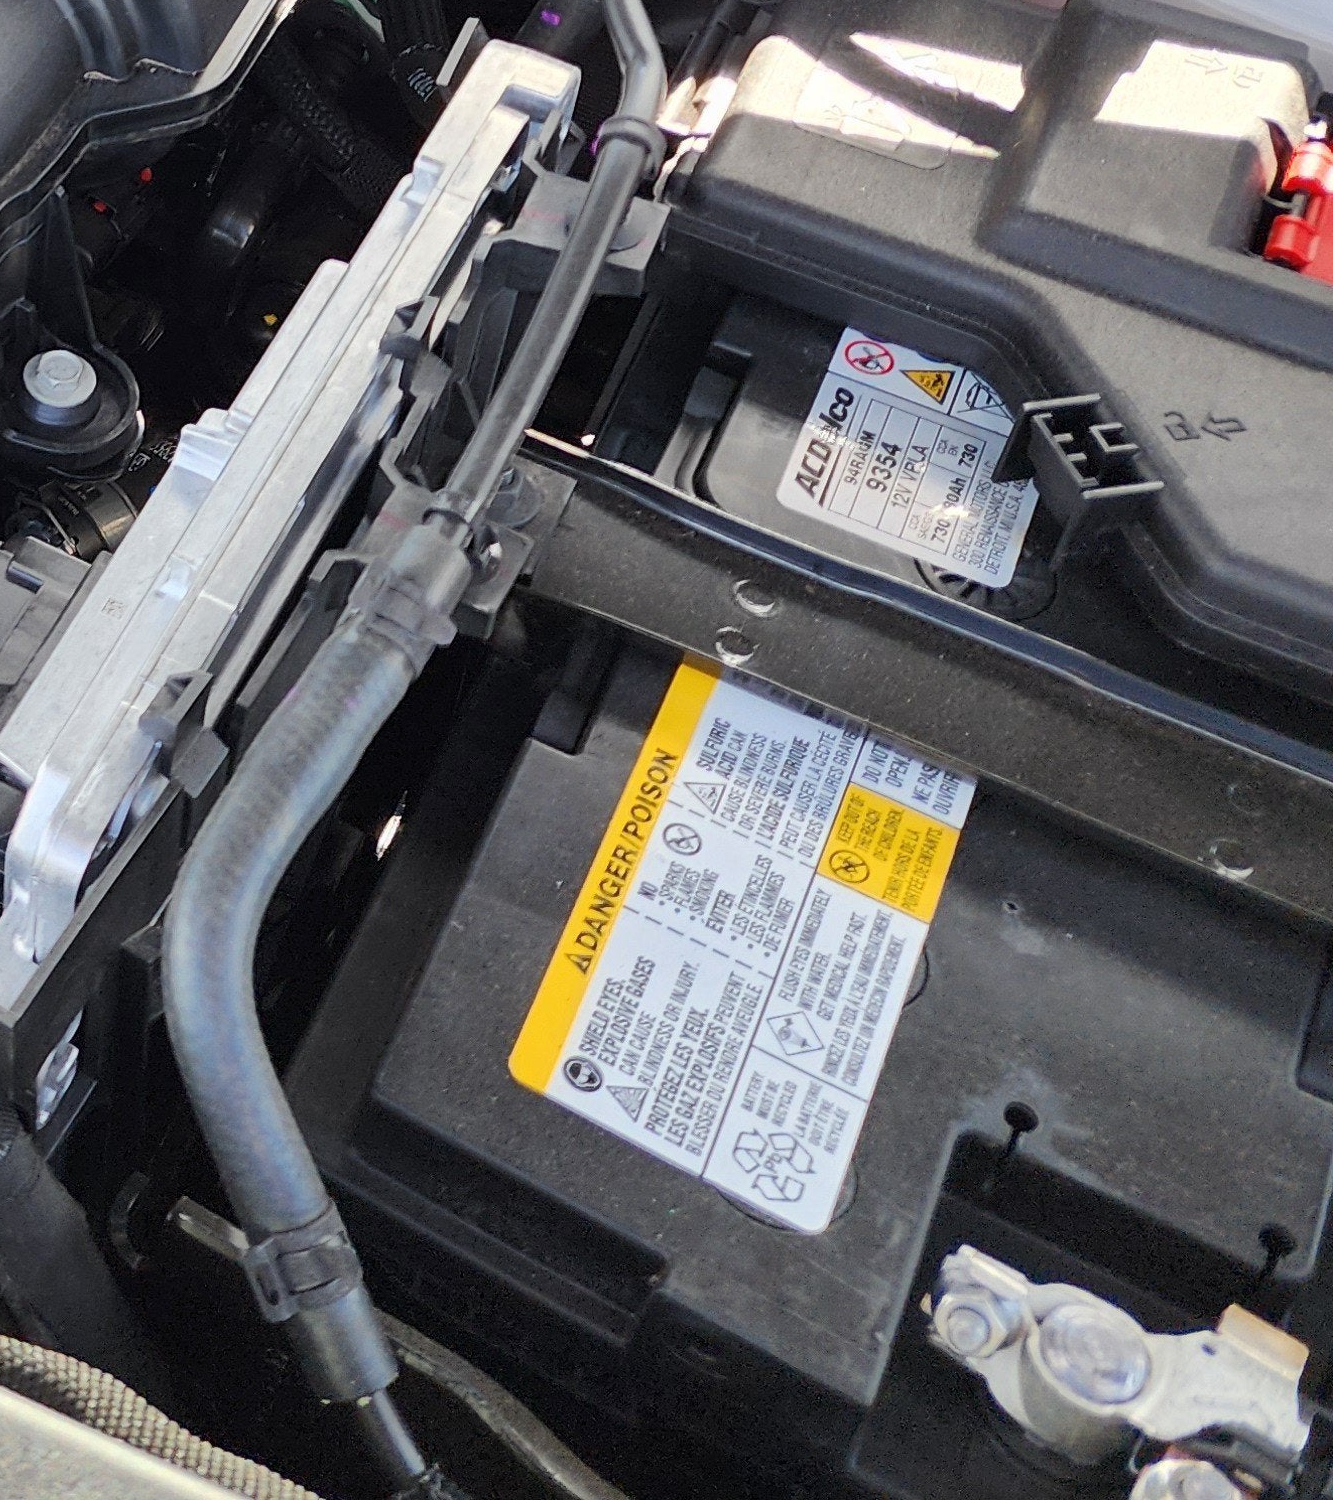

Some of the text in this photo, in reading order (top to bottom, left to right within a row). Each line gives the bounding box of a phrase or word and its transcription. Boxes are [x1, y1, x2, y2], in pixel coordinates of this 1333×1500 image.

[788, 383, 856, 499] ACDlco
[957, 441, 979, 469] 730
[864, 439, 903, 495] 9354
[889, 482, 914, 511] 12V
[930, 516, 951, 545] 730
[967, 547, 986, 569] 300
[693, 714, 732, 773] SULFURIC
[713, 727, 748, 781] ACID CAN
[831, 728, 859, 768] GRAVE
[719, 730, 768, 824] CAUSE BLINDNESS
[770, 734, 813, 803] SULFURIQUE
[805, 764, 824, 782] LA
[860, 763, 883, 785] DO
[744, 772, 773, 816] SEVERE
[788, 780, 818, 824] CAUSER
[911, 784, 932, 805] NE
[737, 810, 758, 832] OR
[778, 818, 803, 851] PEUT
[803, 818, 825, 843] DES
[796, 837, 817, 859] OU
[636, 879, 660, 902] NO
[657, 859, 687, 902] SPARKS
[672, 866, 702, 909] FLAMES
[688, 867, 720, 917] SMOKING
[728, 911, 751, 938] LES
[745, 869, 787, 945] LES FLAMMES
[761, 895, 795, 953] DE FUMER
[788, 944, 811, 972] EYES
[815, 997, 836, 1022] GET
[837, 932, 859, 961] HELP
[777, 967, 802, 1003] FLUSH
[596, 953, 656, 1068] EXPLOSIVE GASES
[679, 1001, 710, 1045] YEUX.
[577, 1009, 611, 1058] SHIELD
[618, 1009, 657, 1078] CAN CAUSE
[636, 1019, 676, 1088] BLINDNESS
[662, 1003, 682, 1023] OR
[669, 1040, 694, 1069] LES
[663, 969, 746, 1148] LES GAZ EXPLOSIFS PEUVENT
[712, 1032, 744, 1084] RENDRE
[705, 1080, 726, 1103] OU
[684, 1098, 719, 1158] BLESSER
[761, 1148, 783, 1174] Pb
